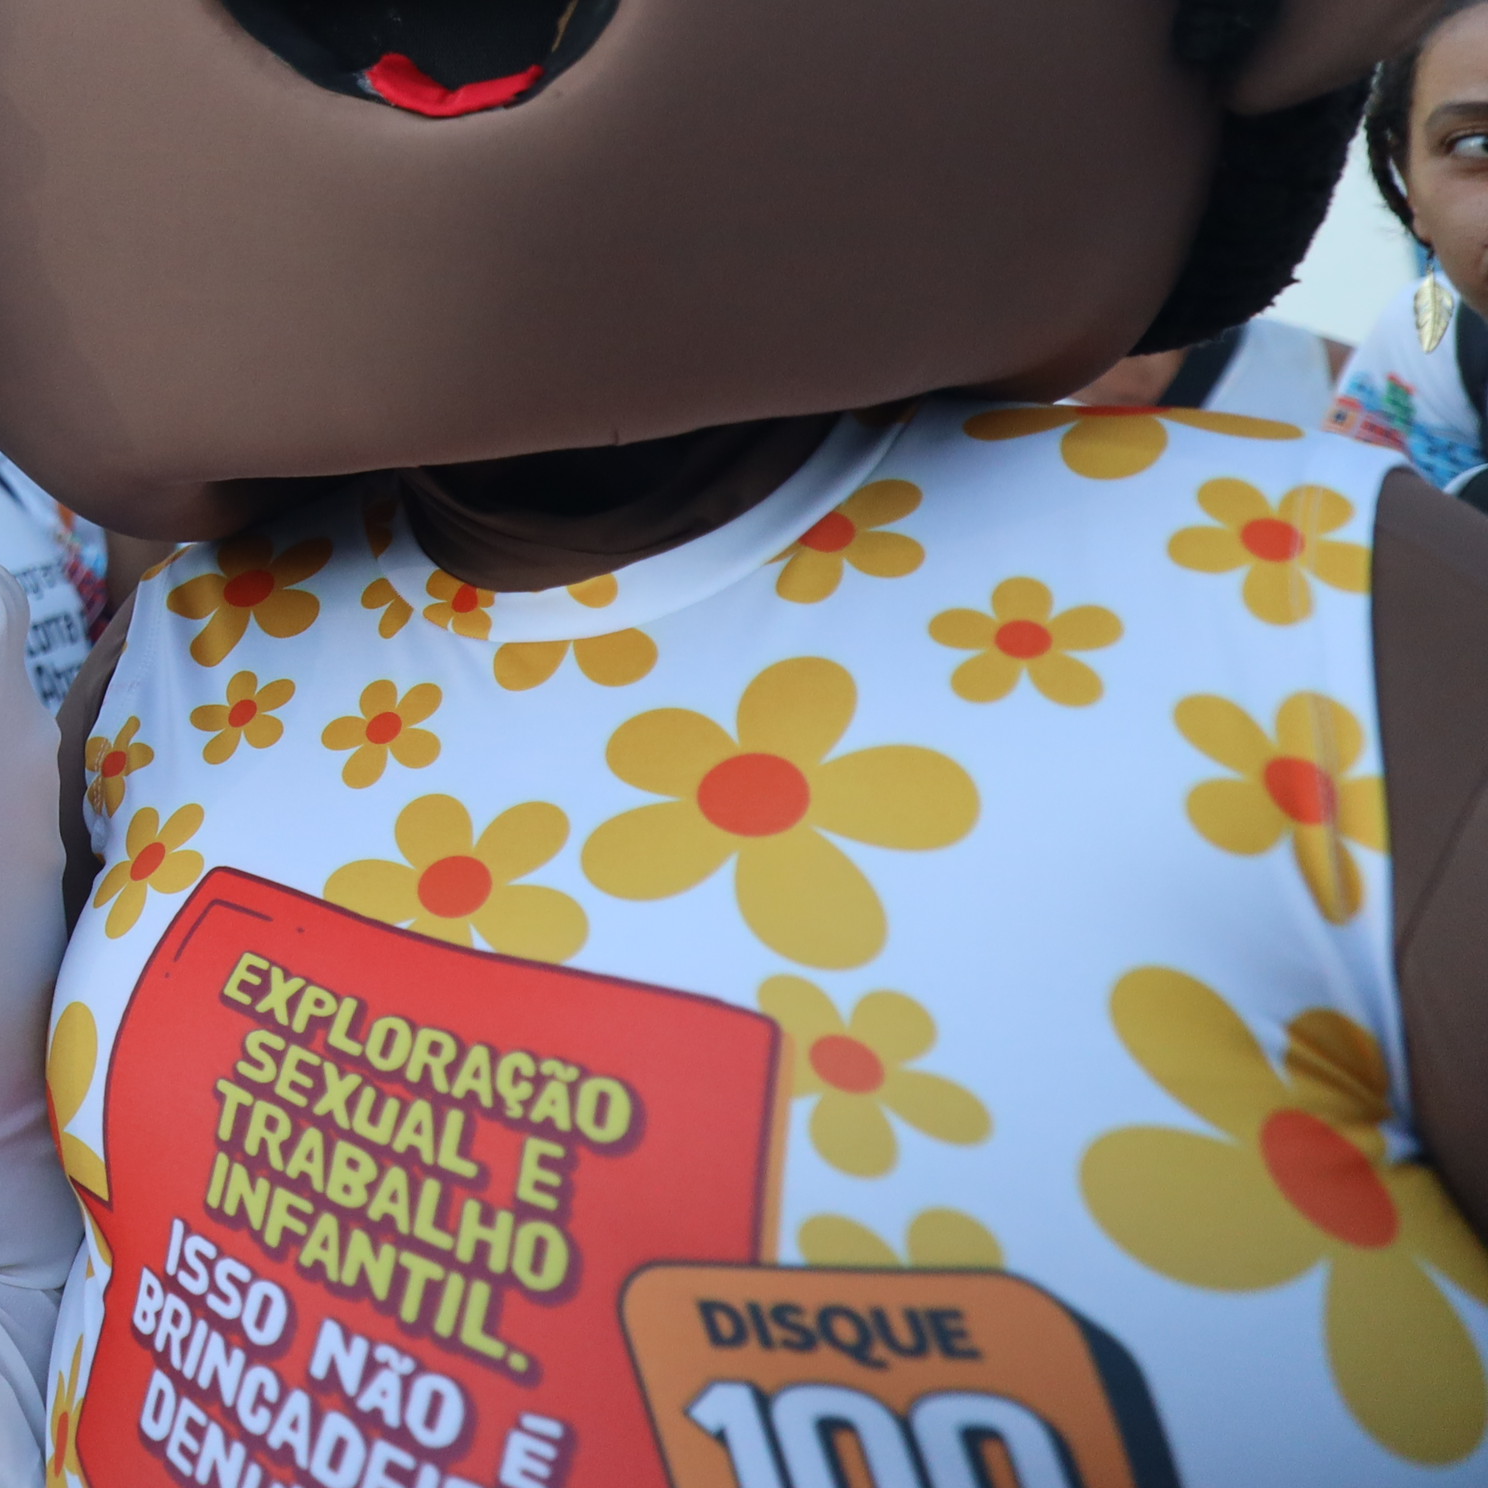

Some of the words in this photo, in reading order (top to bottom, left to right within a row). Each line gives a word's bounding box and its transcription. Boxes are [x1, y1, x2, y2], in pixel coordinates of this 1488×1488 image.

[221, 950, 633, 1145] EXPLORAÇÃO
[236, 1028, 480, 1180] SEXUAL
[515, 1136, 568, 1212] E
[206, 1150, 530, 1374] INFANTIL.
[215, 1077, 571, 1293] TRABALHO
[164, 1217, 290, 1347] ISSO
[308, 1316, 467, 1450] NÃO
[696, 1298, 985, 1372] DISQUE
